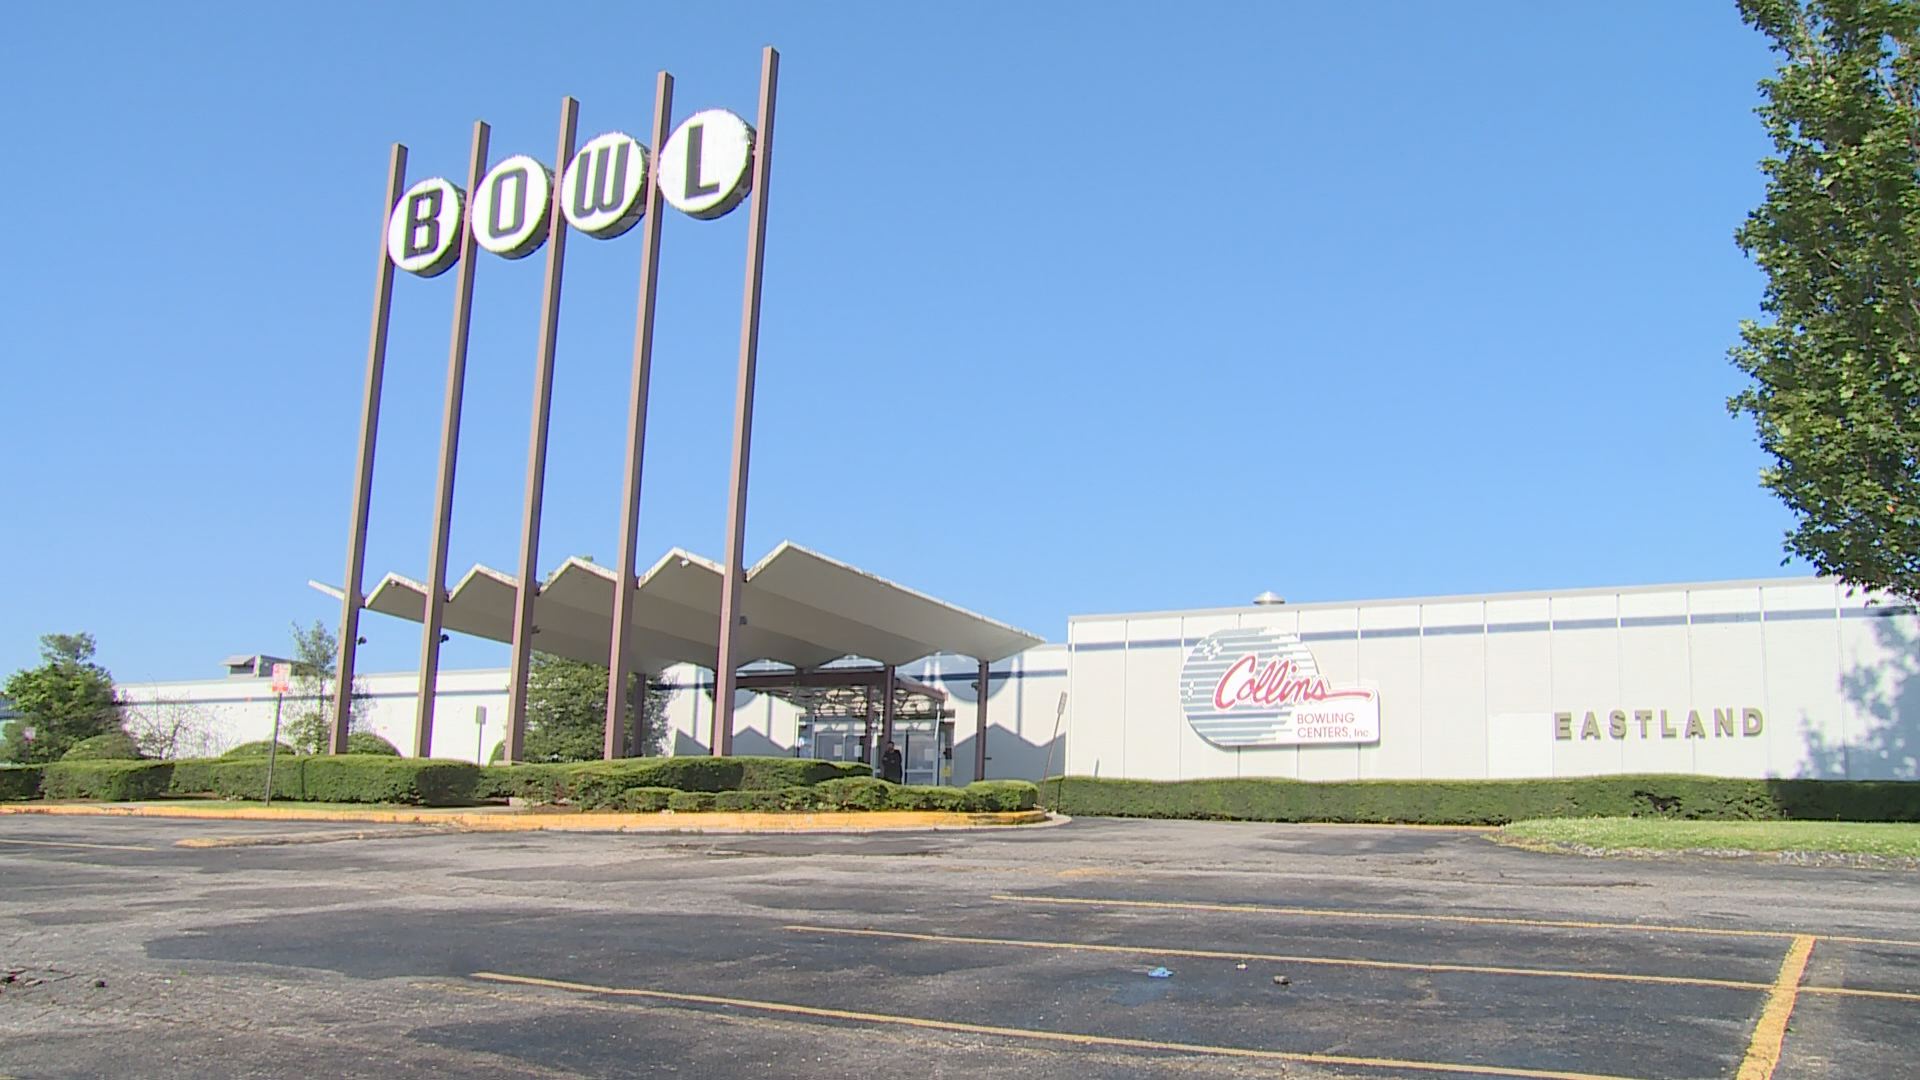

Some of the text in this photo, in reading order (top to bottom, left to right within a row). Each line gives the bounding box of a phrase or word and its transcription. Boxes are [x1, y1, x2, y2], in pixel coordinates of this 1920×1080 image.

[403, 123, 720, 260] BOWL
[1214, 654, 1372, 710] Collins
[1297, 712, 1355, 725] BOWLING
[1297, 726, 1352, 739] CENTERS,
[1554, 707, 1764, 740] EASTLAND
